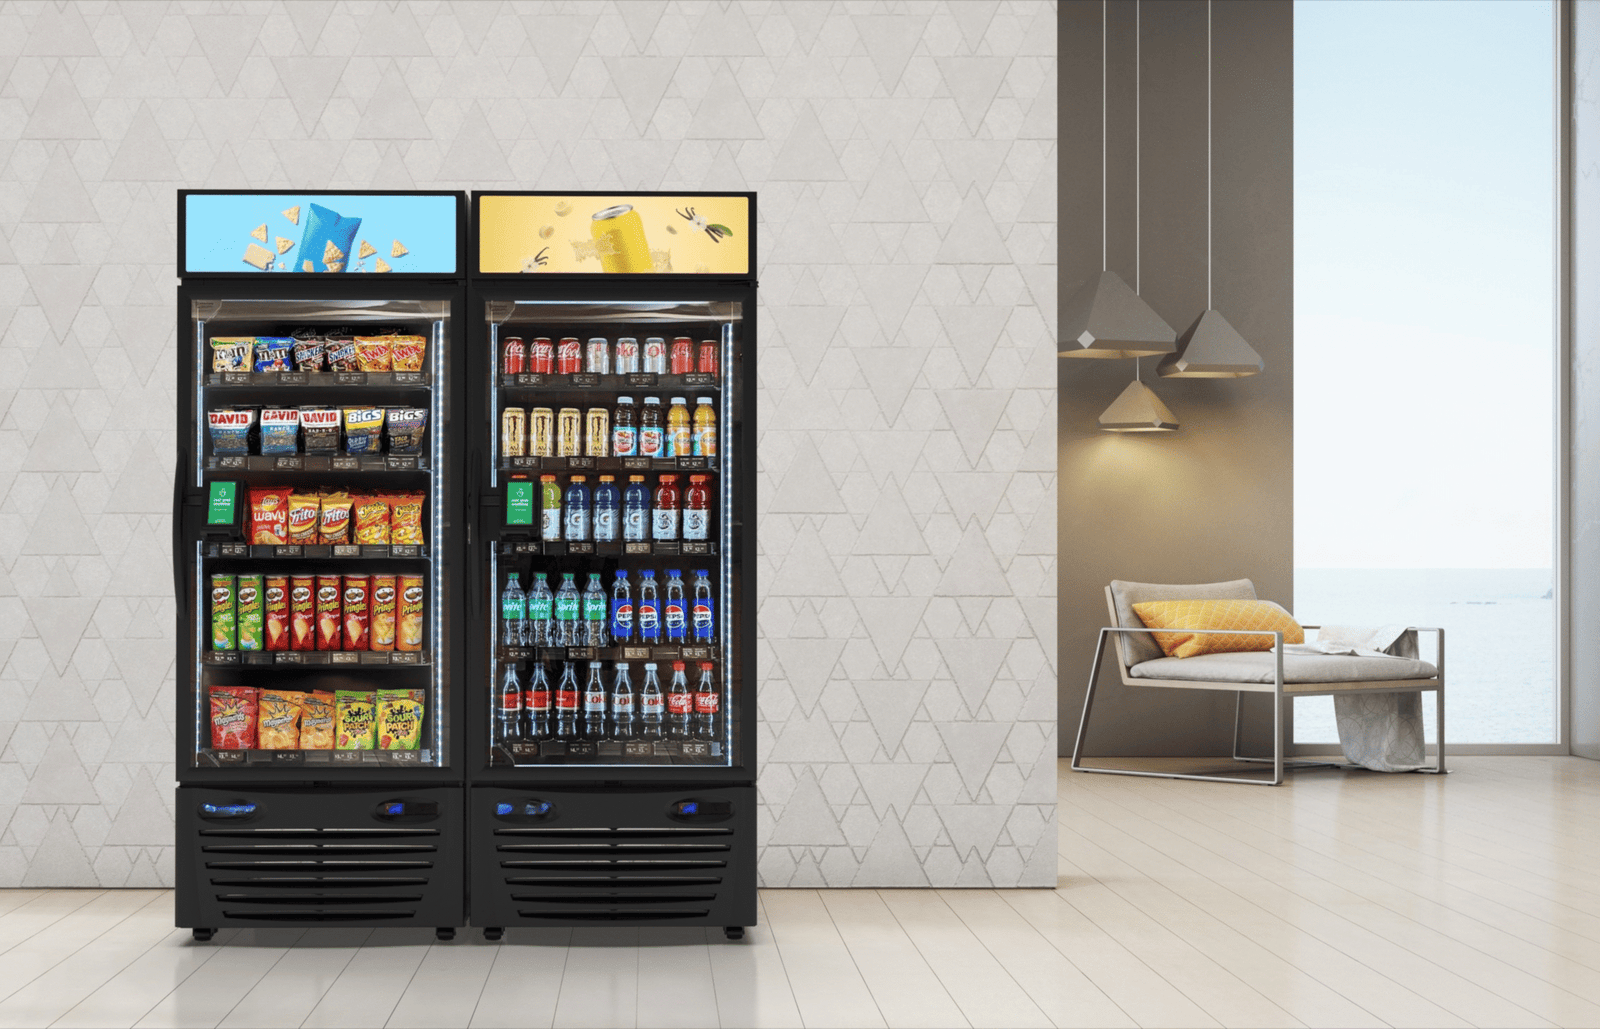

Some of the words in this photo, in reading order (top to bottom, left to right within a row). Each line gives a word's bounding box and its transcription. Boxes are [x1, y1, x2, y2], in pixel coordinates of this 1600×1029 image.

[209, 413, 249, 424] DAVID
[303, 412, 338, 423] DAVID
[254, 511, 286, 523] wavy
